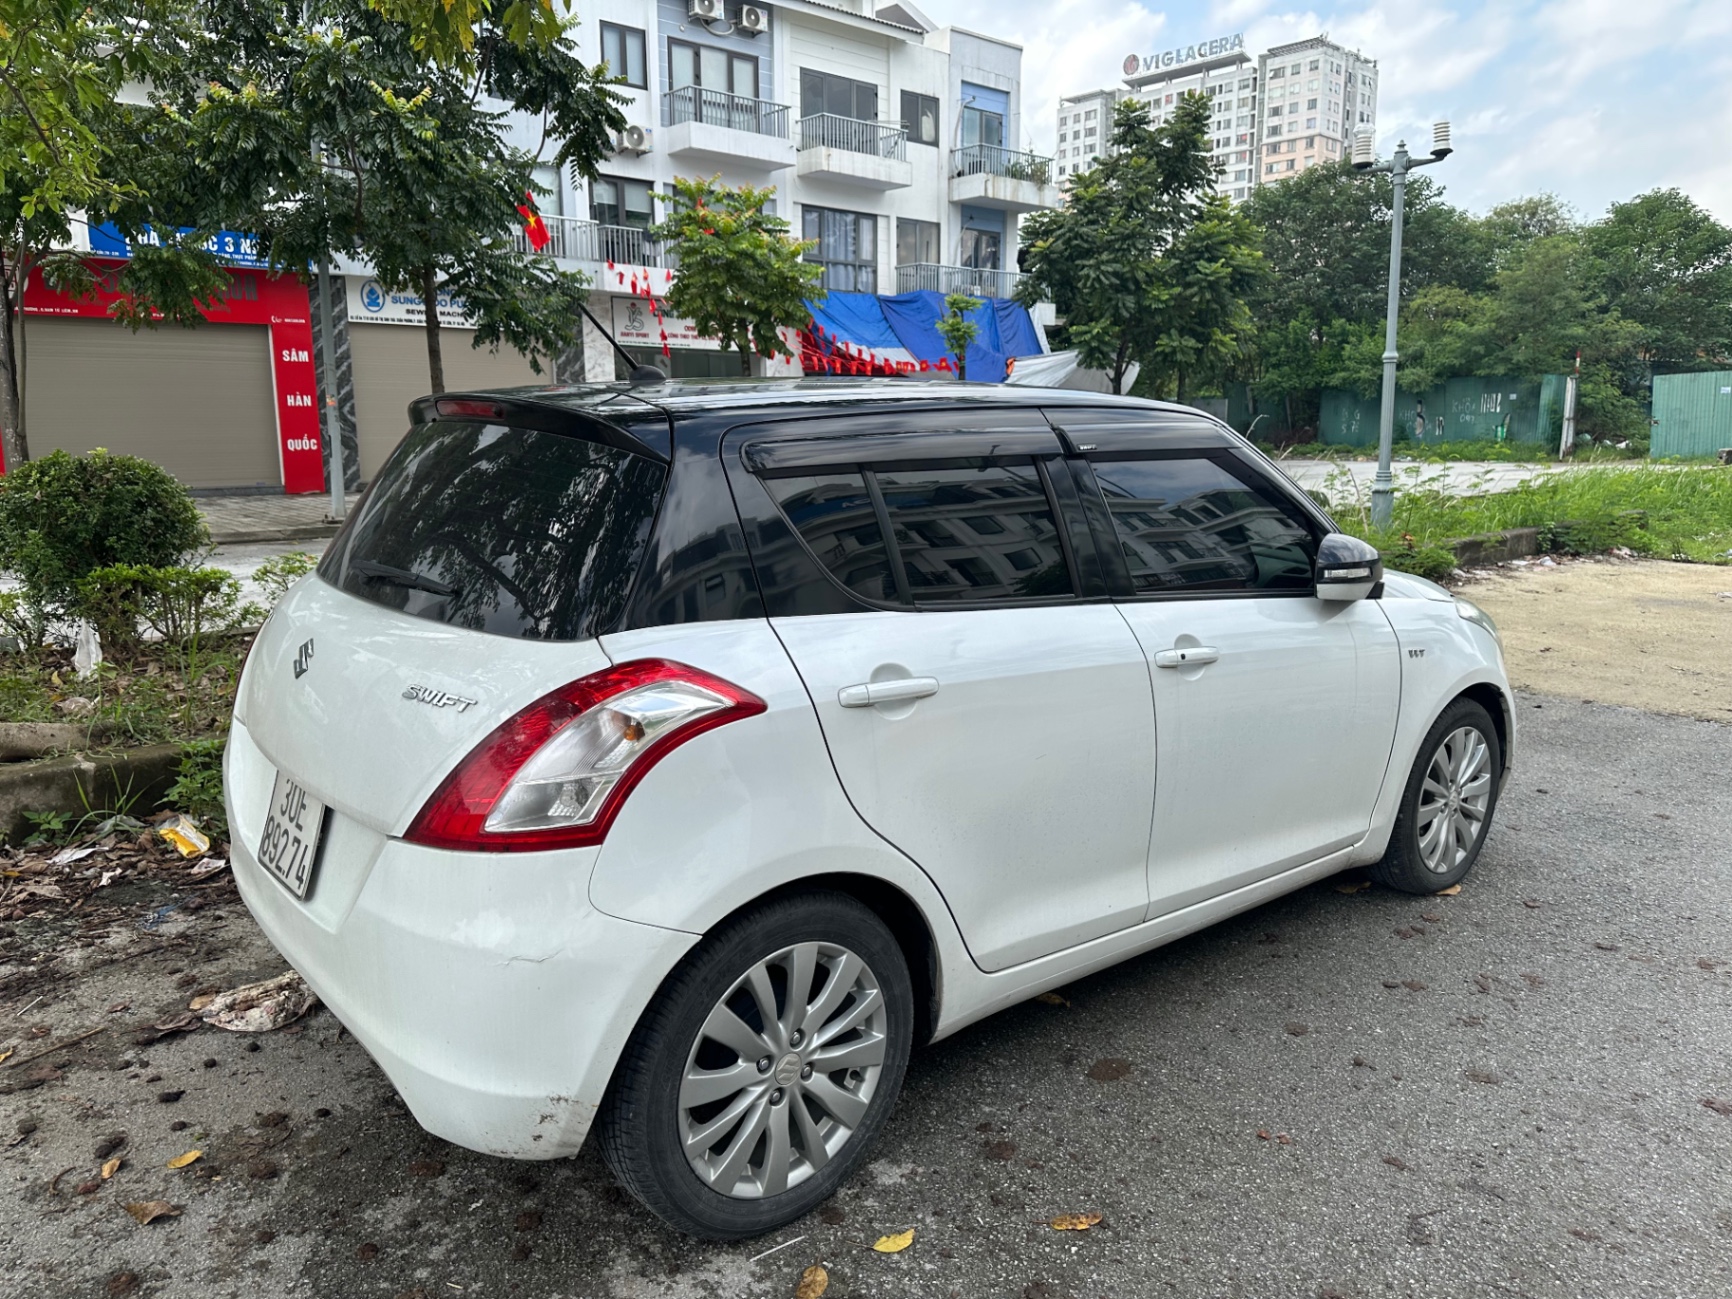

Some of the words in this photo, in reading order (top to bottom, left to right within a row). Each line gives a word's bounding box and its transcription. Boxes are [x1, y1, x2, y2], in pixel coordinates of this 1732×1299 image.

[1142, 33, 1244, 71] VIGLACERA
[224, 236, 235, 252] 3
[282, 348, 309, 362] SÂM
[286, 391, 312, 407] HÀN
[287, 434, 318, 451] QUỐC
[401, 683, 478, 713] SWIFT
[280, 778, 307, 832] 30E
[261, 815, 309, 890] 892.74
